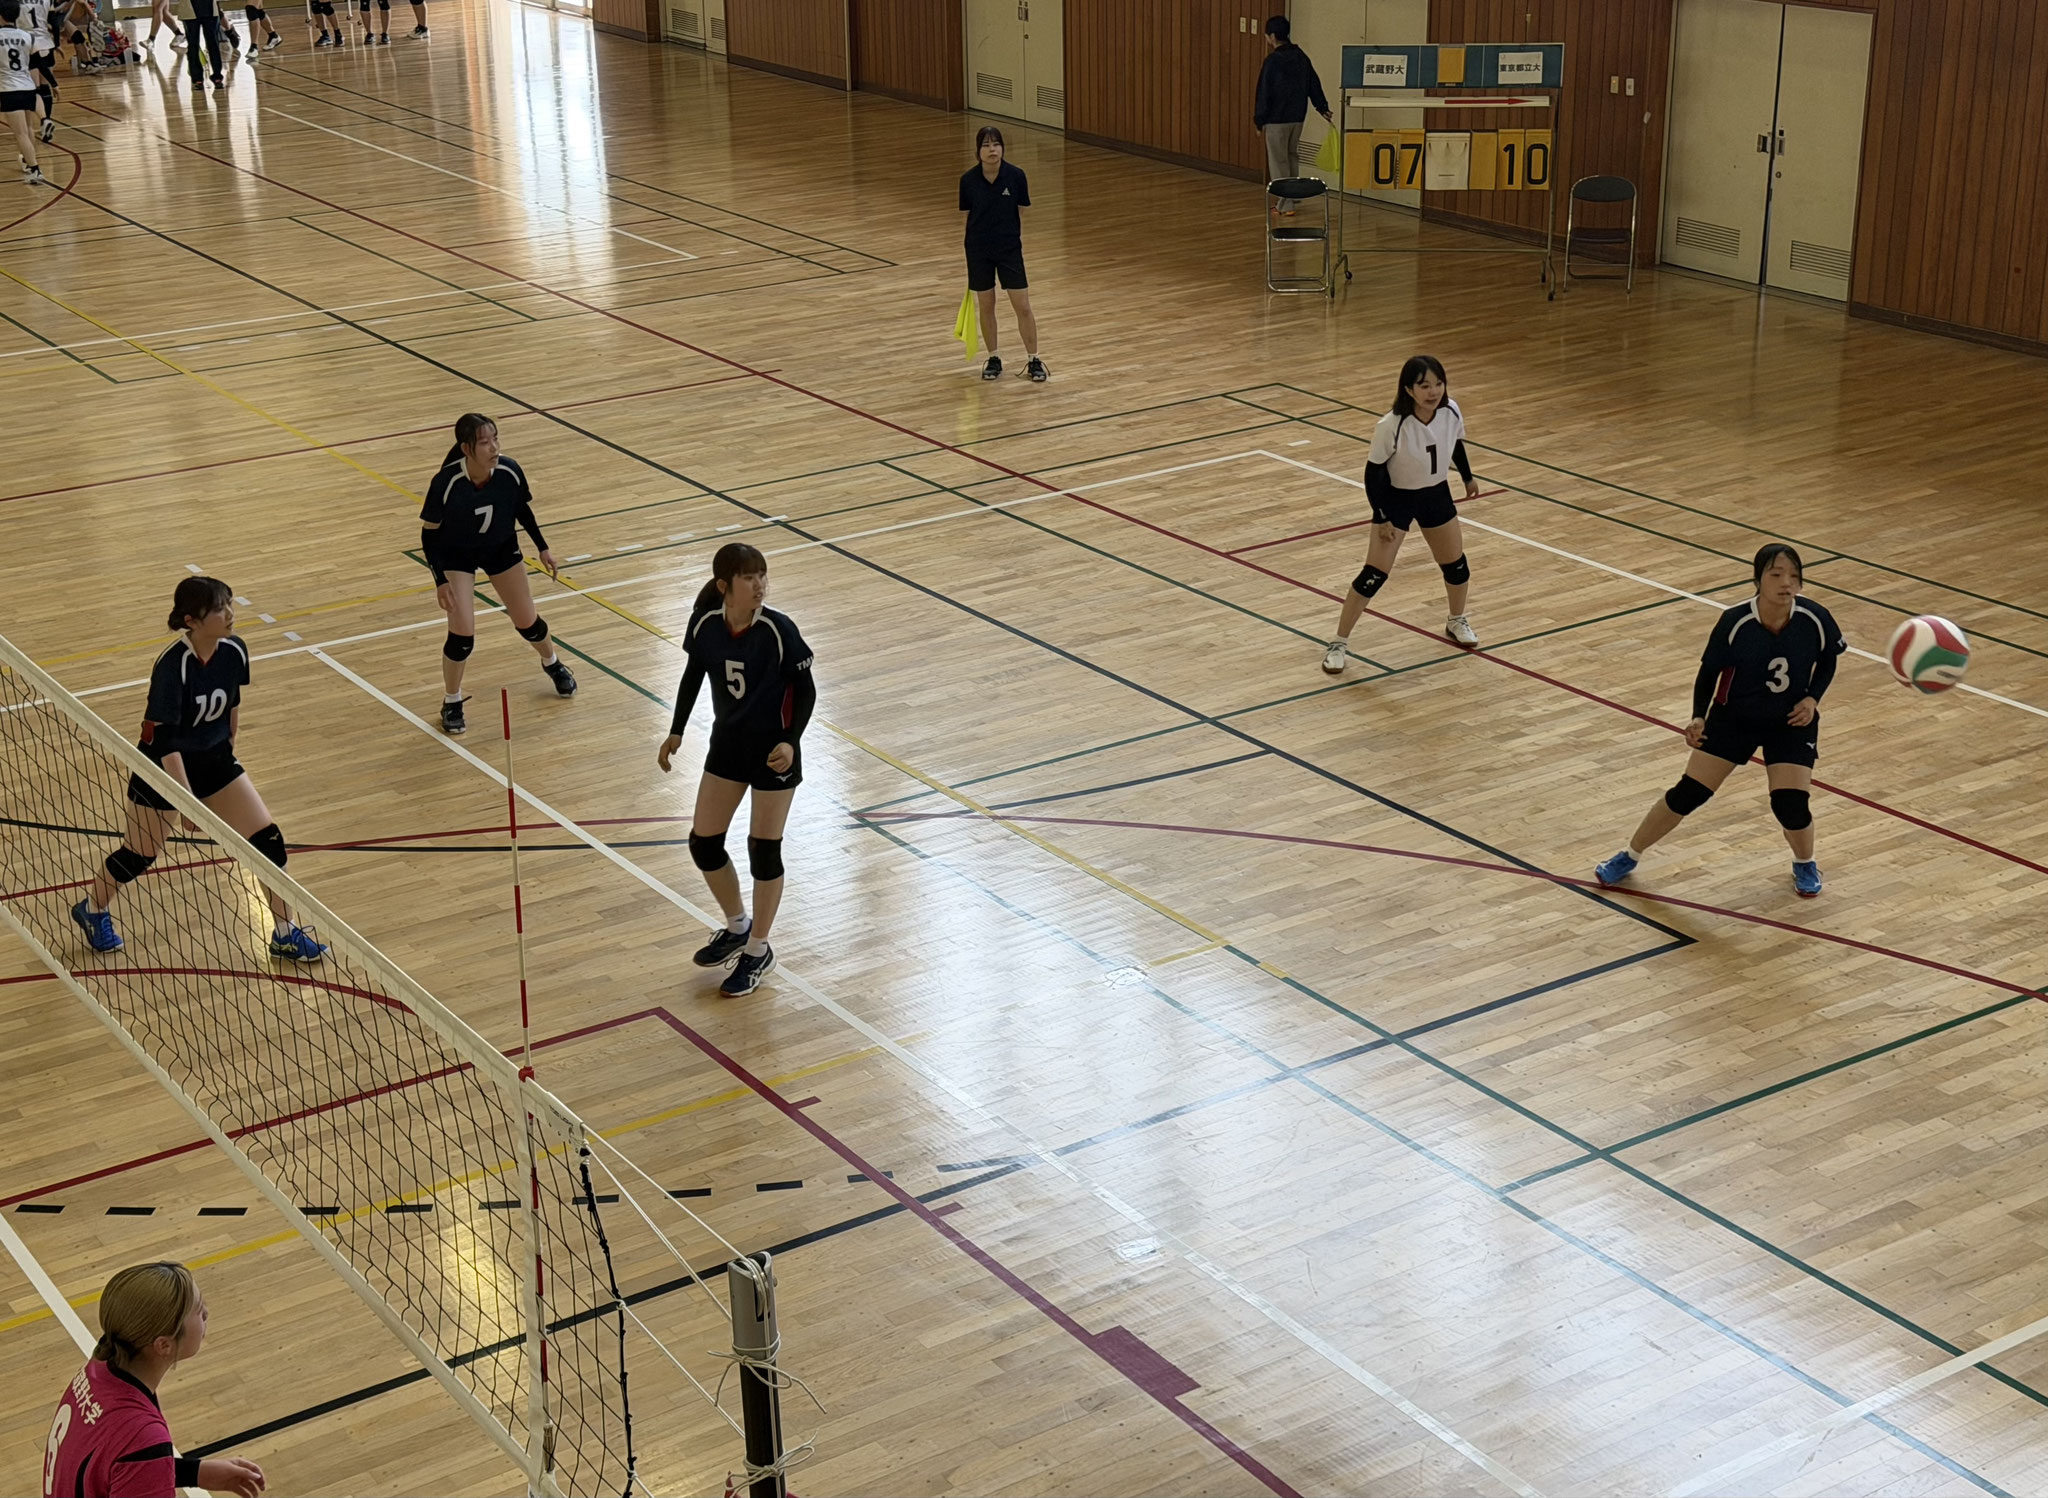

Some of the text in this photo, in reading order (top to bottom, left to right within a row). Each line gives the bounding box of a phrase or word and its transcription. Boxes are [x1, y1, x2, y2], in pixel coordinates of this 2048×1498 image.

[28, 7, 39, 29] 1
[8, 48, 22, 71] 8
[1365, 64, 1405, 74] 武蔵野大
[1500, 63, 1541, 72] 東京都立大
[1375, 143, 1422, 185] 07
[1503, 143, 1549, 186] 10
[1425, 443, 1438, 475] 1
[474, 504, 493, 534] 7
[725, 659, 746, 700] 5
[1765, 656, 1790, 694] 3
[192, 688, 227, 728] 10
